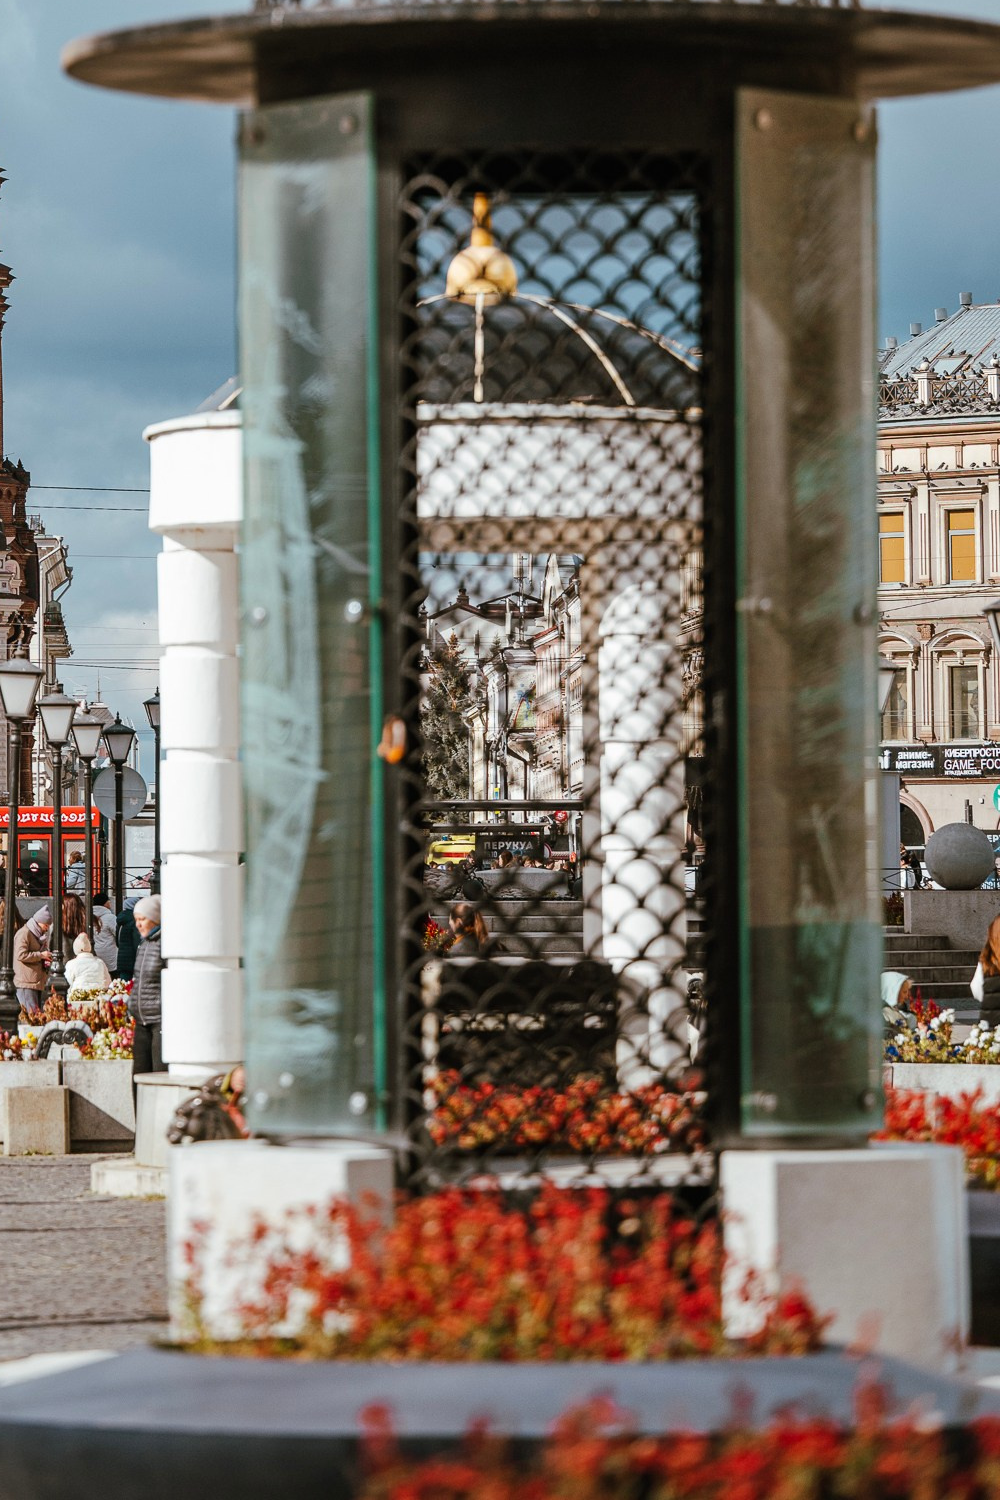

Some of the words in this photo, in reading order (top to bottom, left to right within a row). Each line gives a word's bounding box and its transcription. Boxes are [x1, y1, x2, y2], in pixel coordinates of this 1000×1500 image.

[897, 751, 932, 760] аниме-
[895, 760, 934, 769] магазин
[944, 759, 977, 770] GAME.
